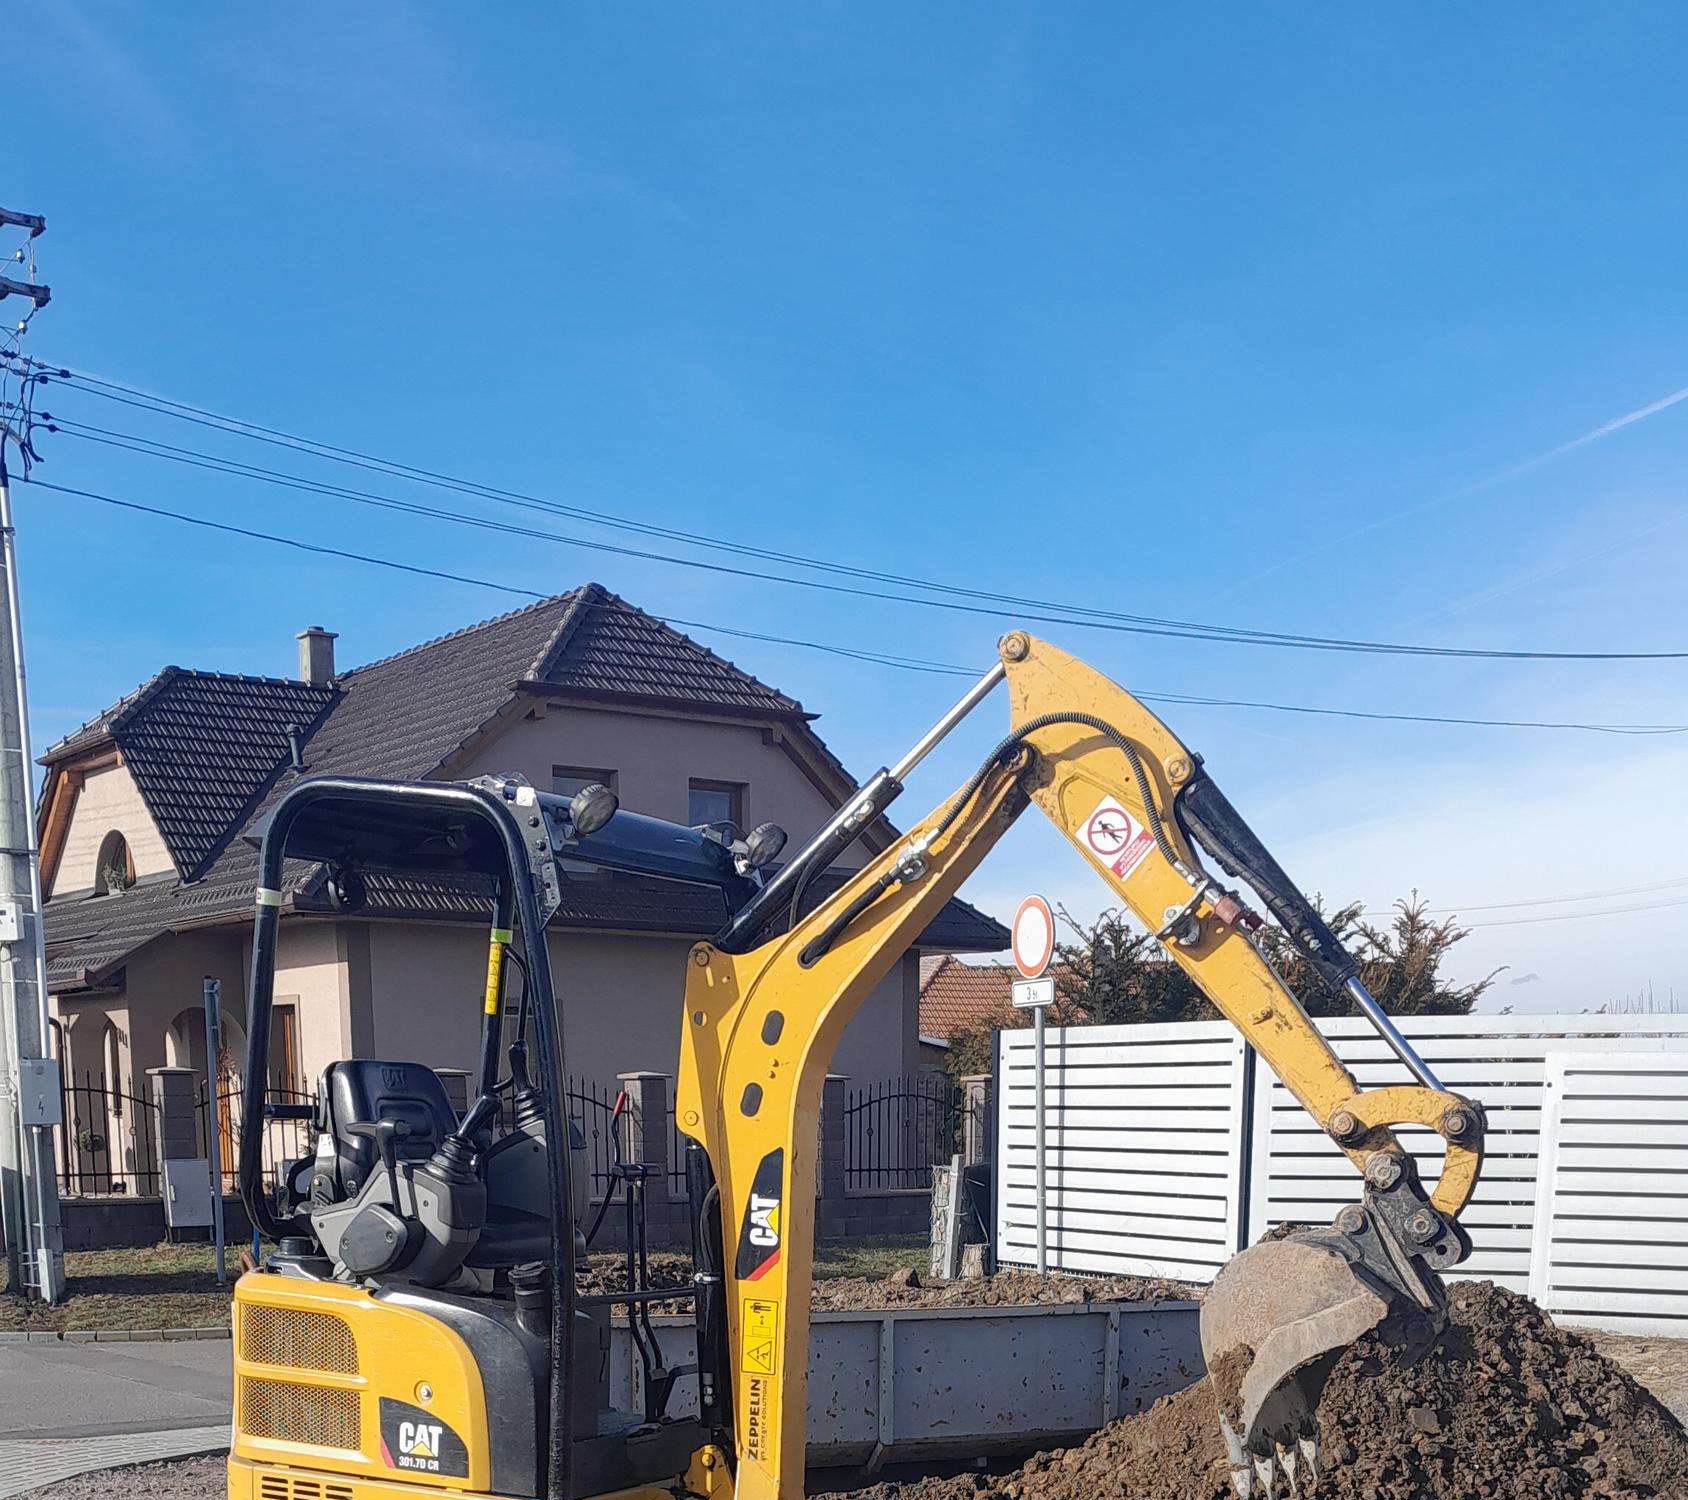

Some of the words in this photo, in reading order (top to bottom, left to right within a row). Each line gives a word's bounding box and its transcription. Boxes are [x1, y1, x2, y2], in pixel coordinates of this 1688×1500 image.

[750, 1193, 780, 1246] CAT
[399, 1421, 443, 1458] CAT
[748, 1378, 761, 1460] ZEPPELIN
[398, 1455, 426, 1470] 301.7D
[427, 1459, 440, 1471] CR
